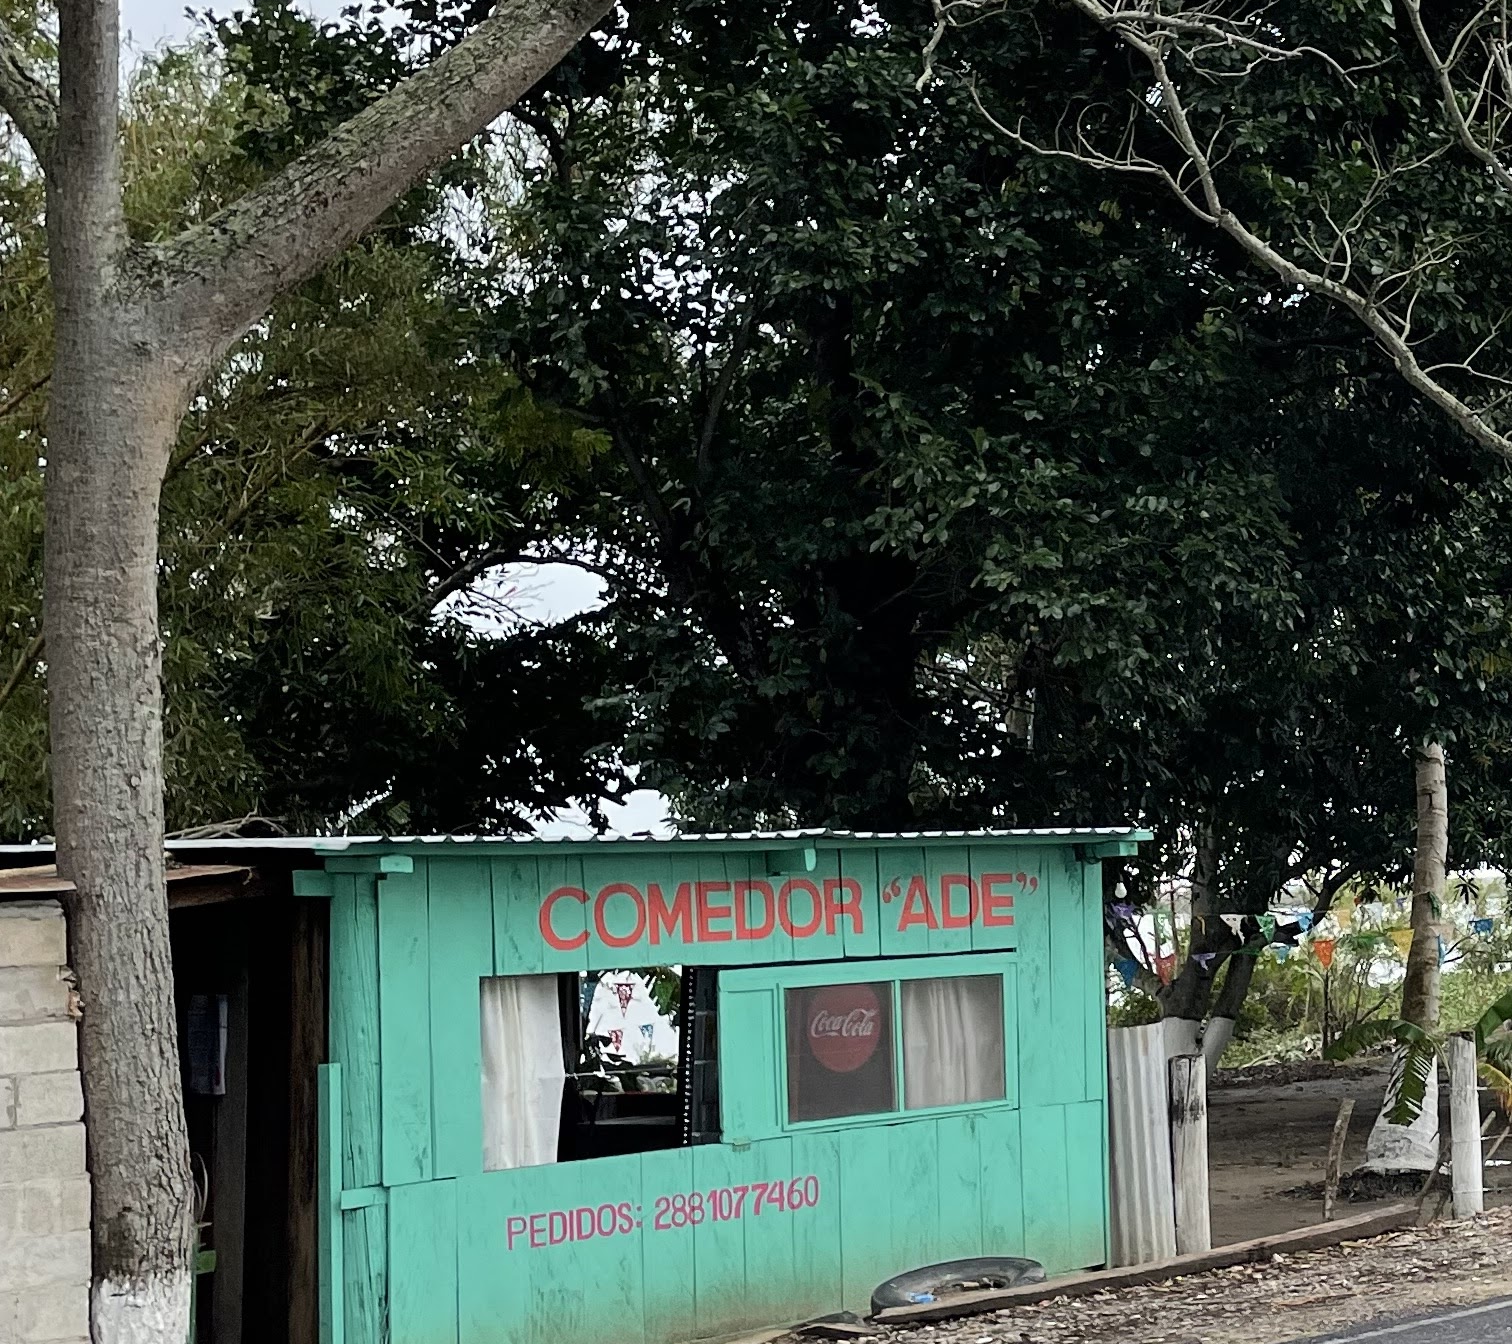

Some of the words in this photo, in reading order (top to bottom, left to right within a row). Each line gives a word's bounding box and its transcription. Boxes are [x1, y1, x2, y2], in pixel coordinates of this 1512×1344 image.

[538, 878, 864, 951] COMEDOR
[506, 1201, 643, 1251] PEDIDOS:
[654, 1175, 820, 1231] 2881077460
